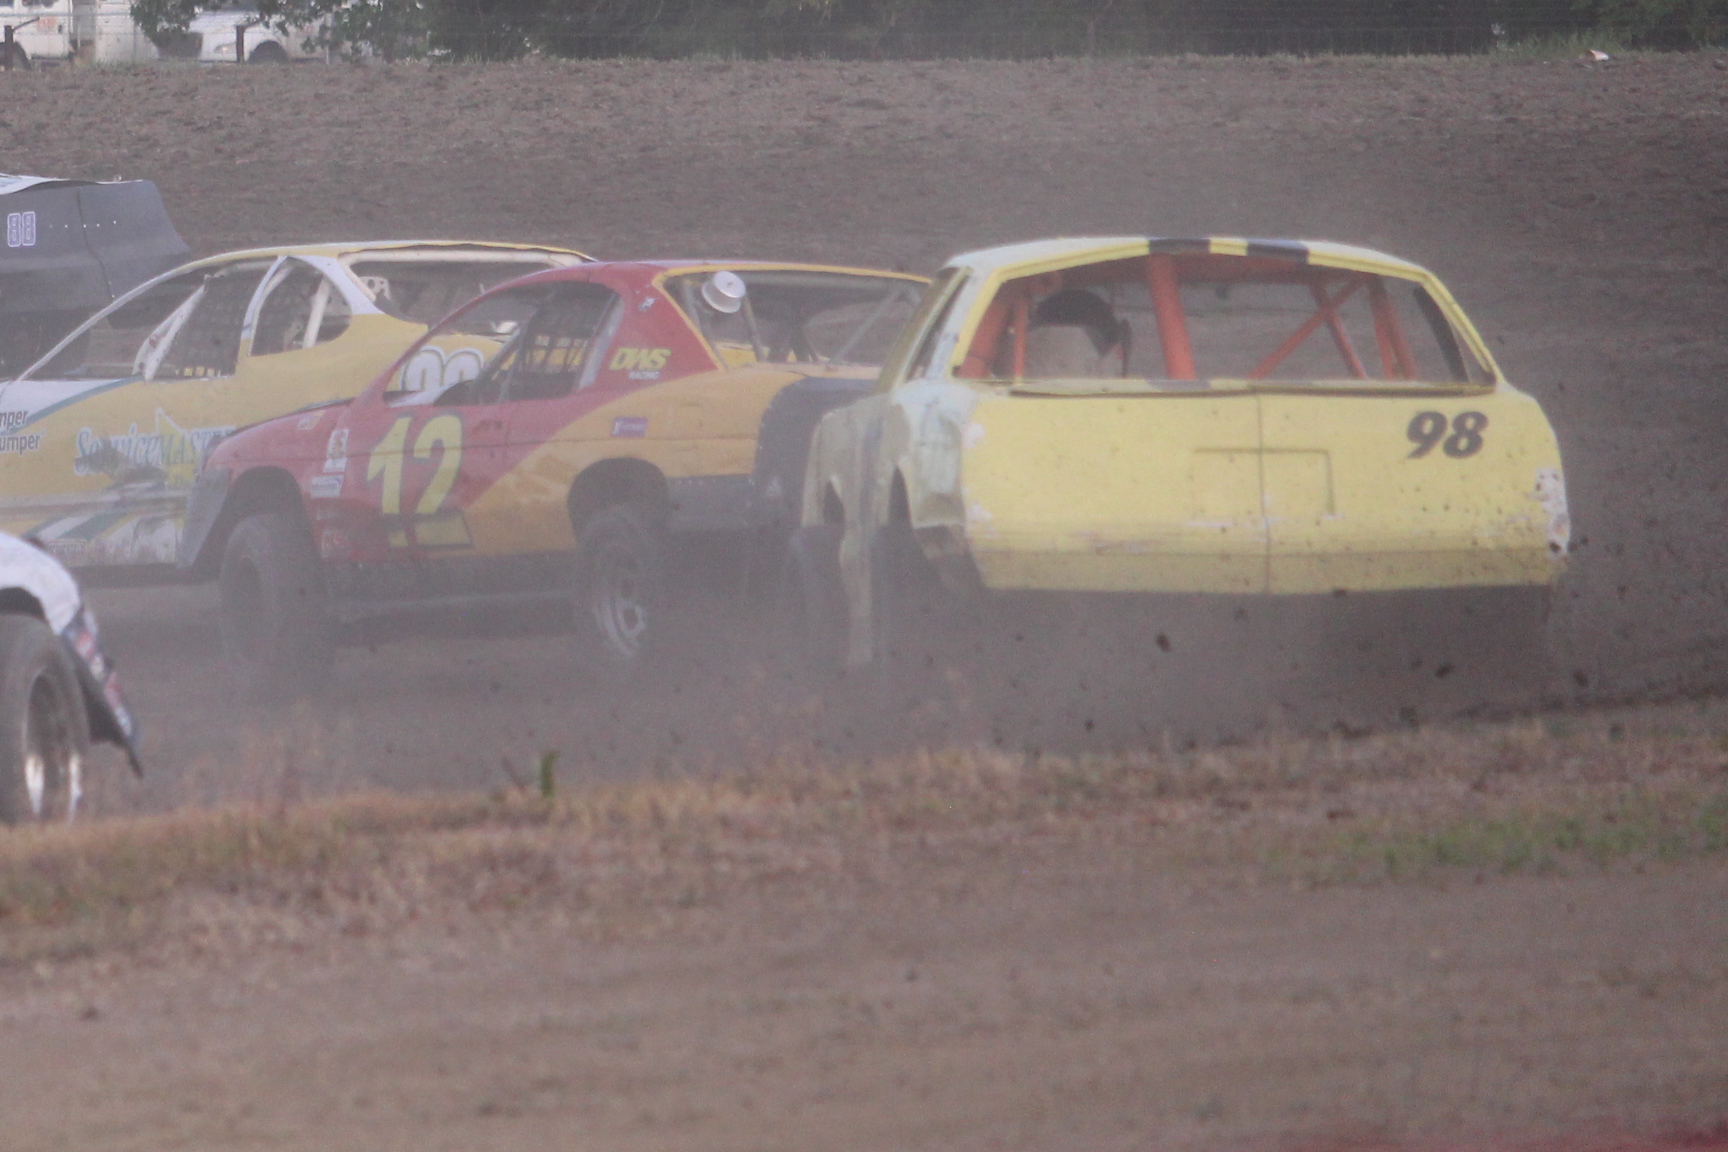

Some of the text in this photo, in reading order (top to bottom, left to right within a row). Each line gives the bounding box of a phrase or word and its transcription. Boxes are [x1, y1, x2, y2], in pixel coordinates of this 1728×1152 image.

[7, 211, 36, 248] 88
[609, 347, 672, 371] DWS
[1406, 411, 1489, 459] 98
[364, 410, 473, 548] 12
